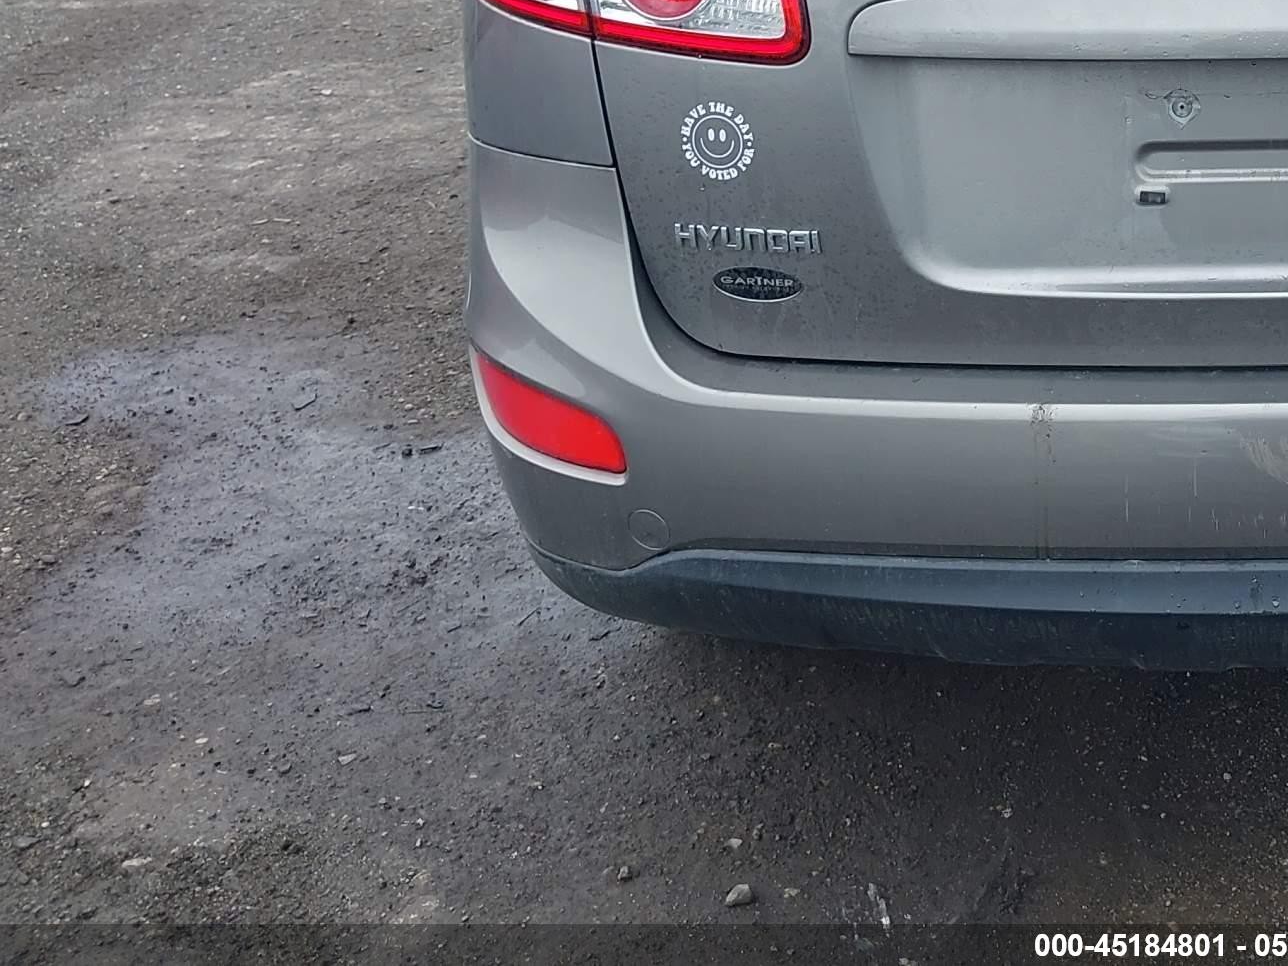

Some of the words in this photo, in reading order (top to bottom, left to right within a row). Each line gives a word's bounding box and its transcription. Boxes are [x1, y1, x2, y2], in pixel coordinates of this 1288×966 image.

[681, 104, 707, 137] HAVE
[708, 102, 735, 117] THE
[734, 114, 754, 143] DAY
[681, 143, 701, 168] YOU
[701, 165, 739, 181] VOTED
[737, 148, 755, 172] FOR
[674, 223, 822, 254] HYUNDAI
[720, 275, 794, 287] GARTNER
